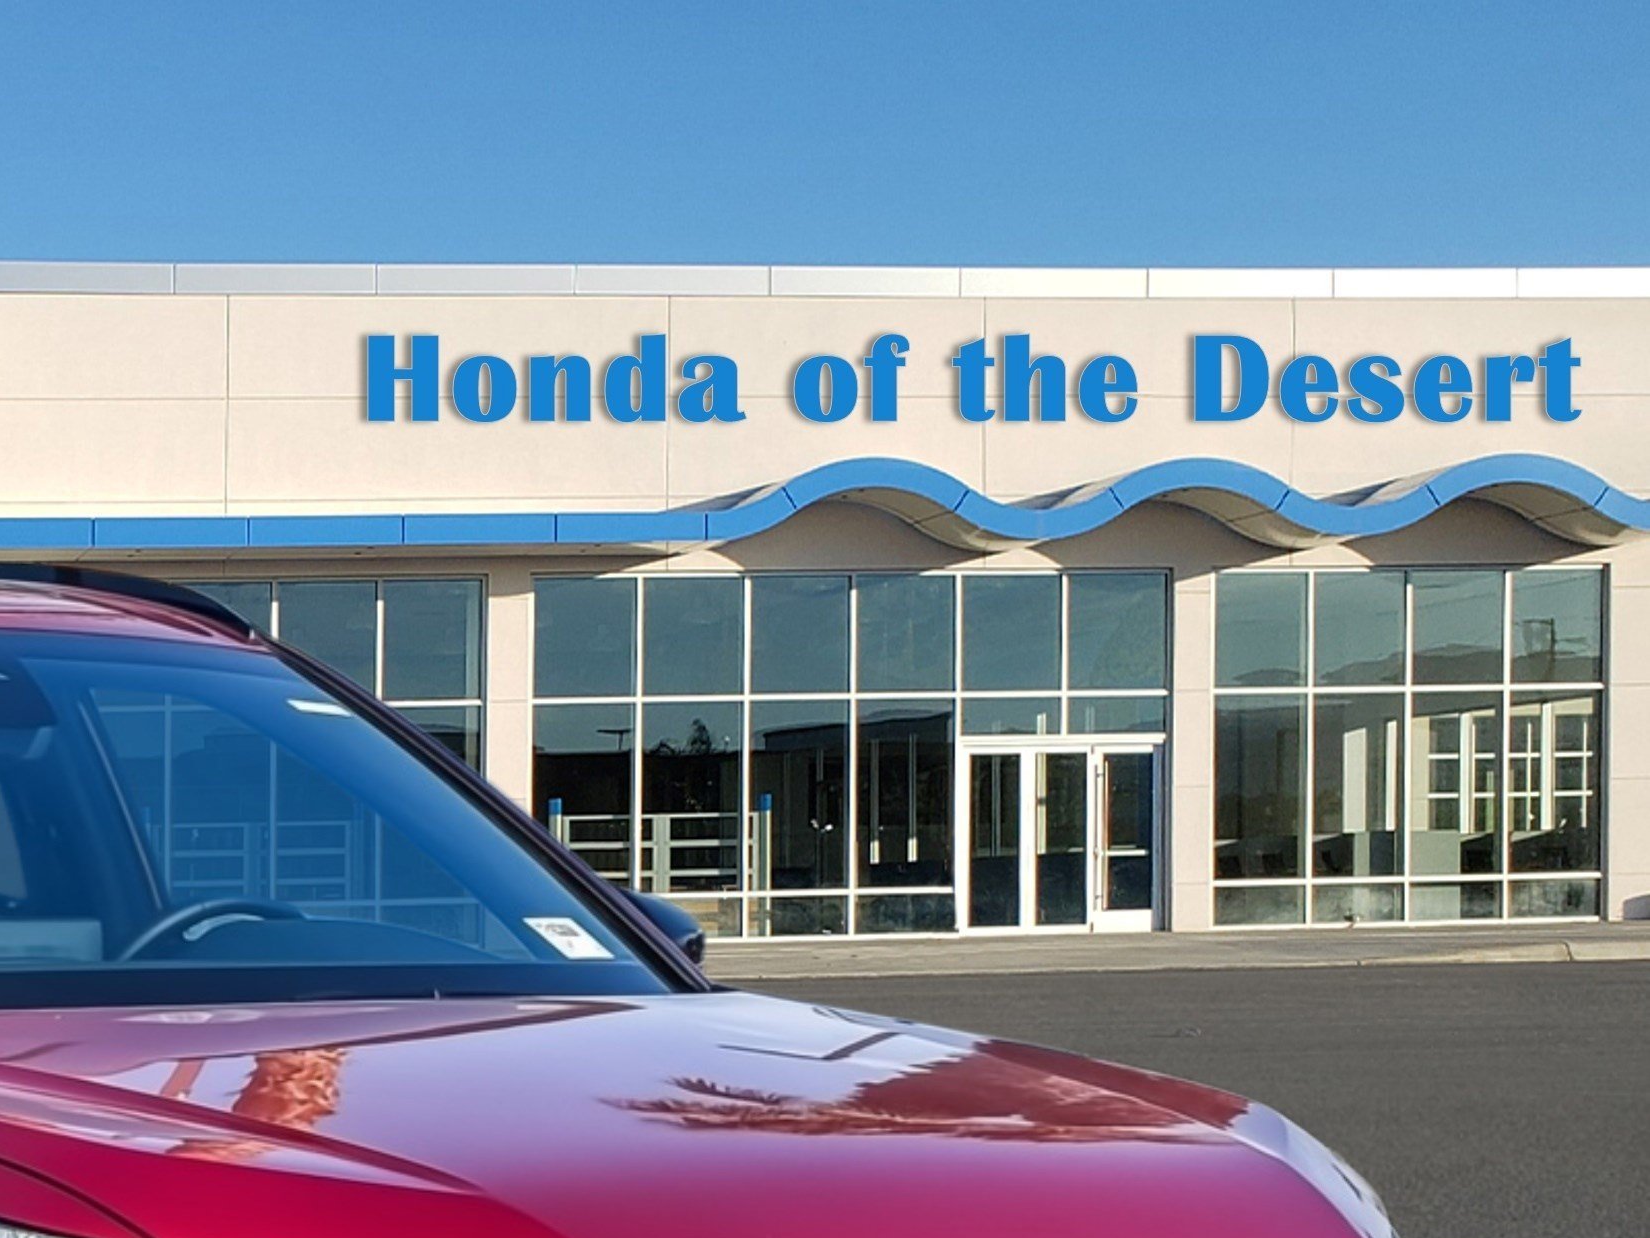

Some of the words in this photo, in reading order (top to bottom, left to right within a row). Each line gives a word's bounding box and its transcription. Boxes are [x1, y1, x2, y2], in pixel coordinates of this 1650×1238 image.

[366, 333, 747, 424] Honda
[794, 333, 912, 424] of
[951, 333, 1140, 424] the
[1194, 333, 1583, 424] Desert
